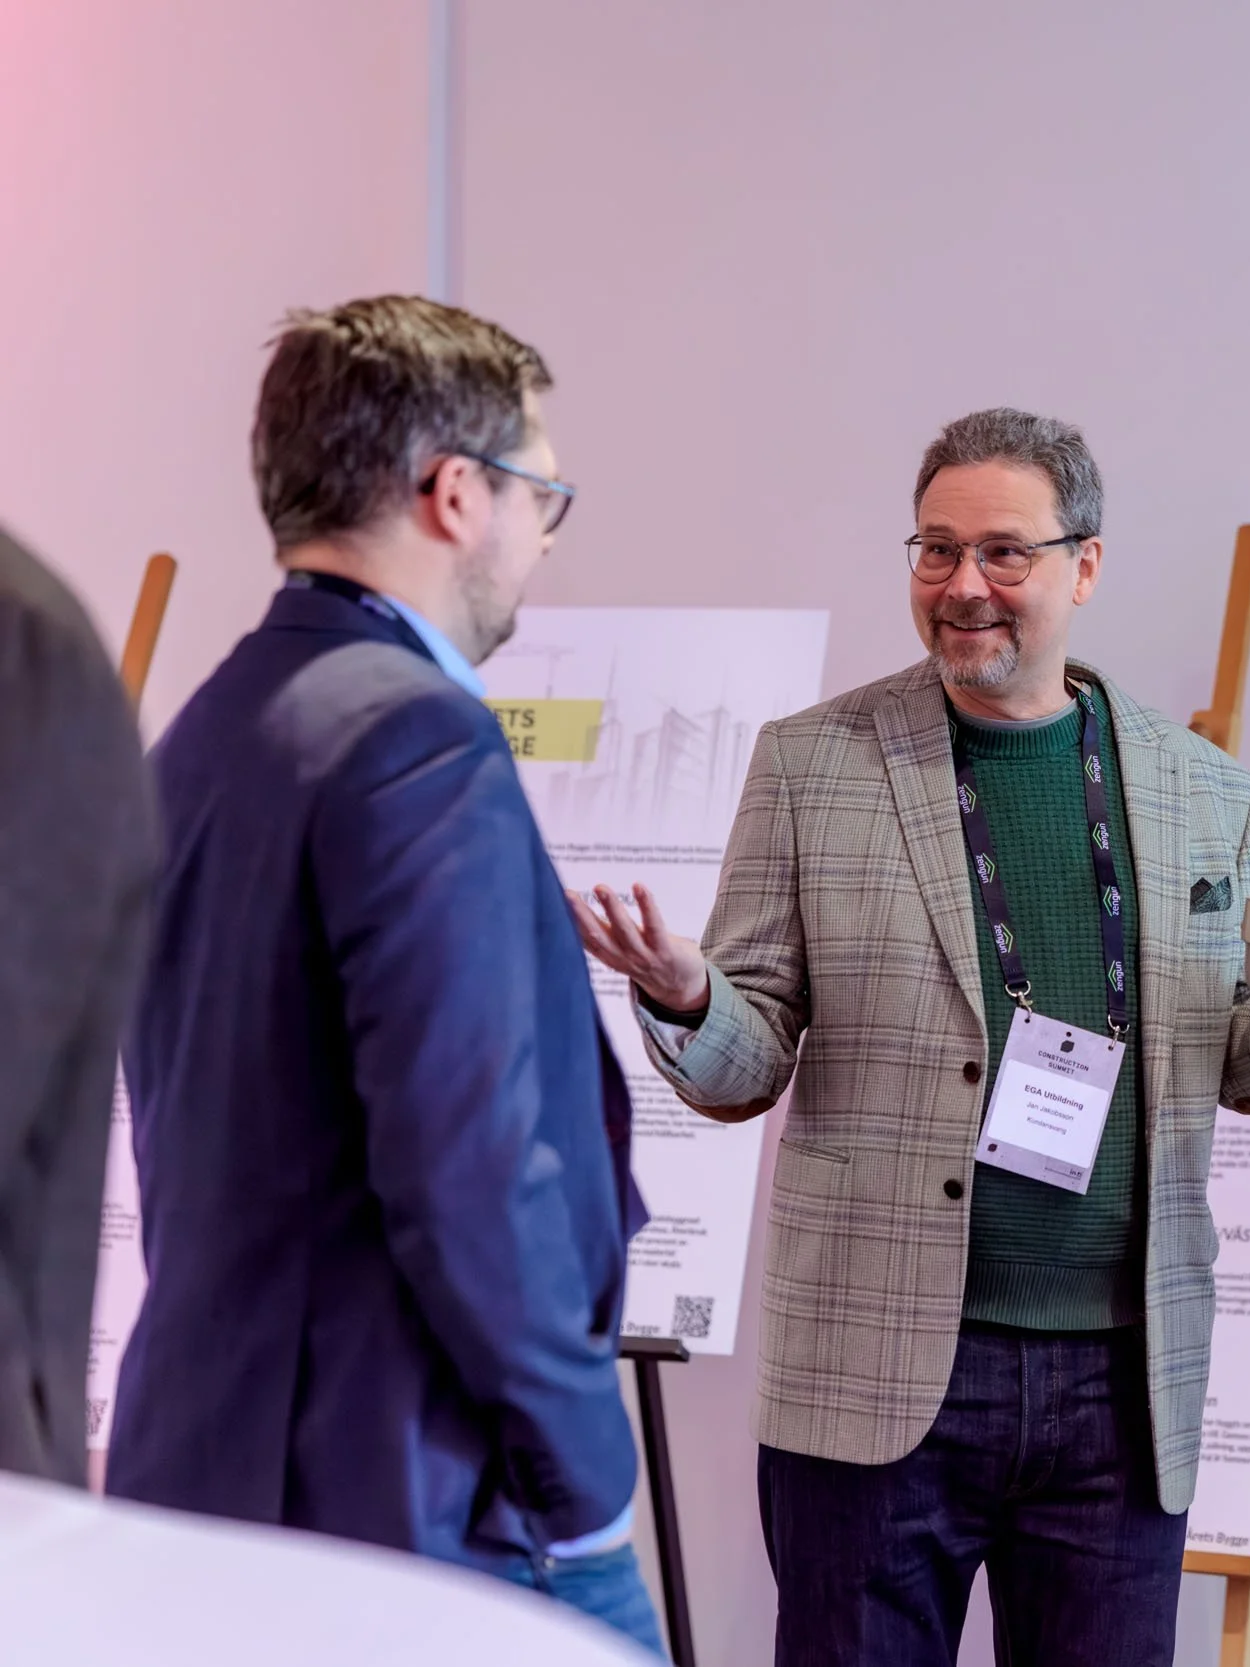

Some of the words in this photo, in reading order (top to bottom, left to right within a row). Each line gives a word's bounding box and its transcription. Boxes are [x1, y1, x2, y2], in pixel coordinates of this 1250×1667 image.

[1093, 755, 1102, 783] zengun
[957, 785, 970, 814] zengun
[1100, 822, 1109, 850] zengun
[976, 854, 988, 884] zengun
[1112, 886, 1121, 916] zengun
[994, 924, 1008, 954] zengun
[1116, 961, 1124, 992] zengun
[1038, 1050, 1089, 1072] CONSTRUCTION
[1048, 1062, 1074, 1075] SUMMIT
[1025, 1084, 1042, 1096] EGA
[1044, 1090, 1084, 1111] Utbildning
